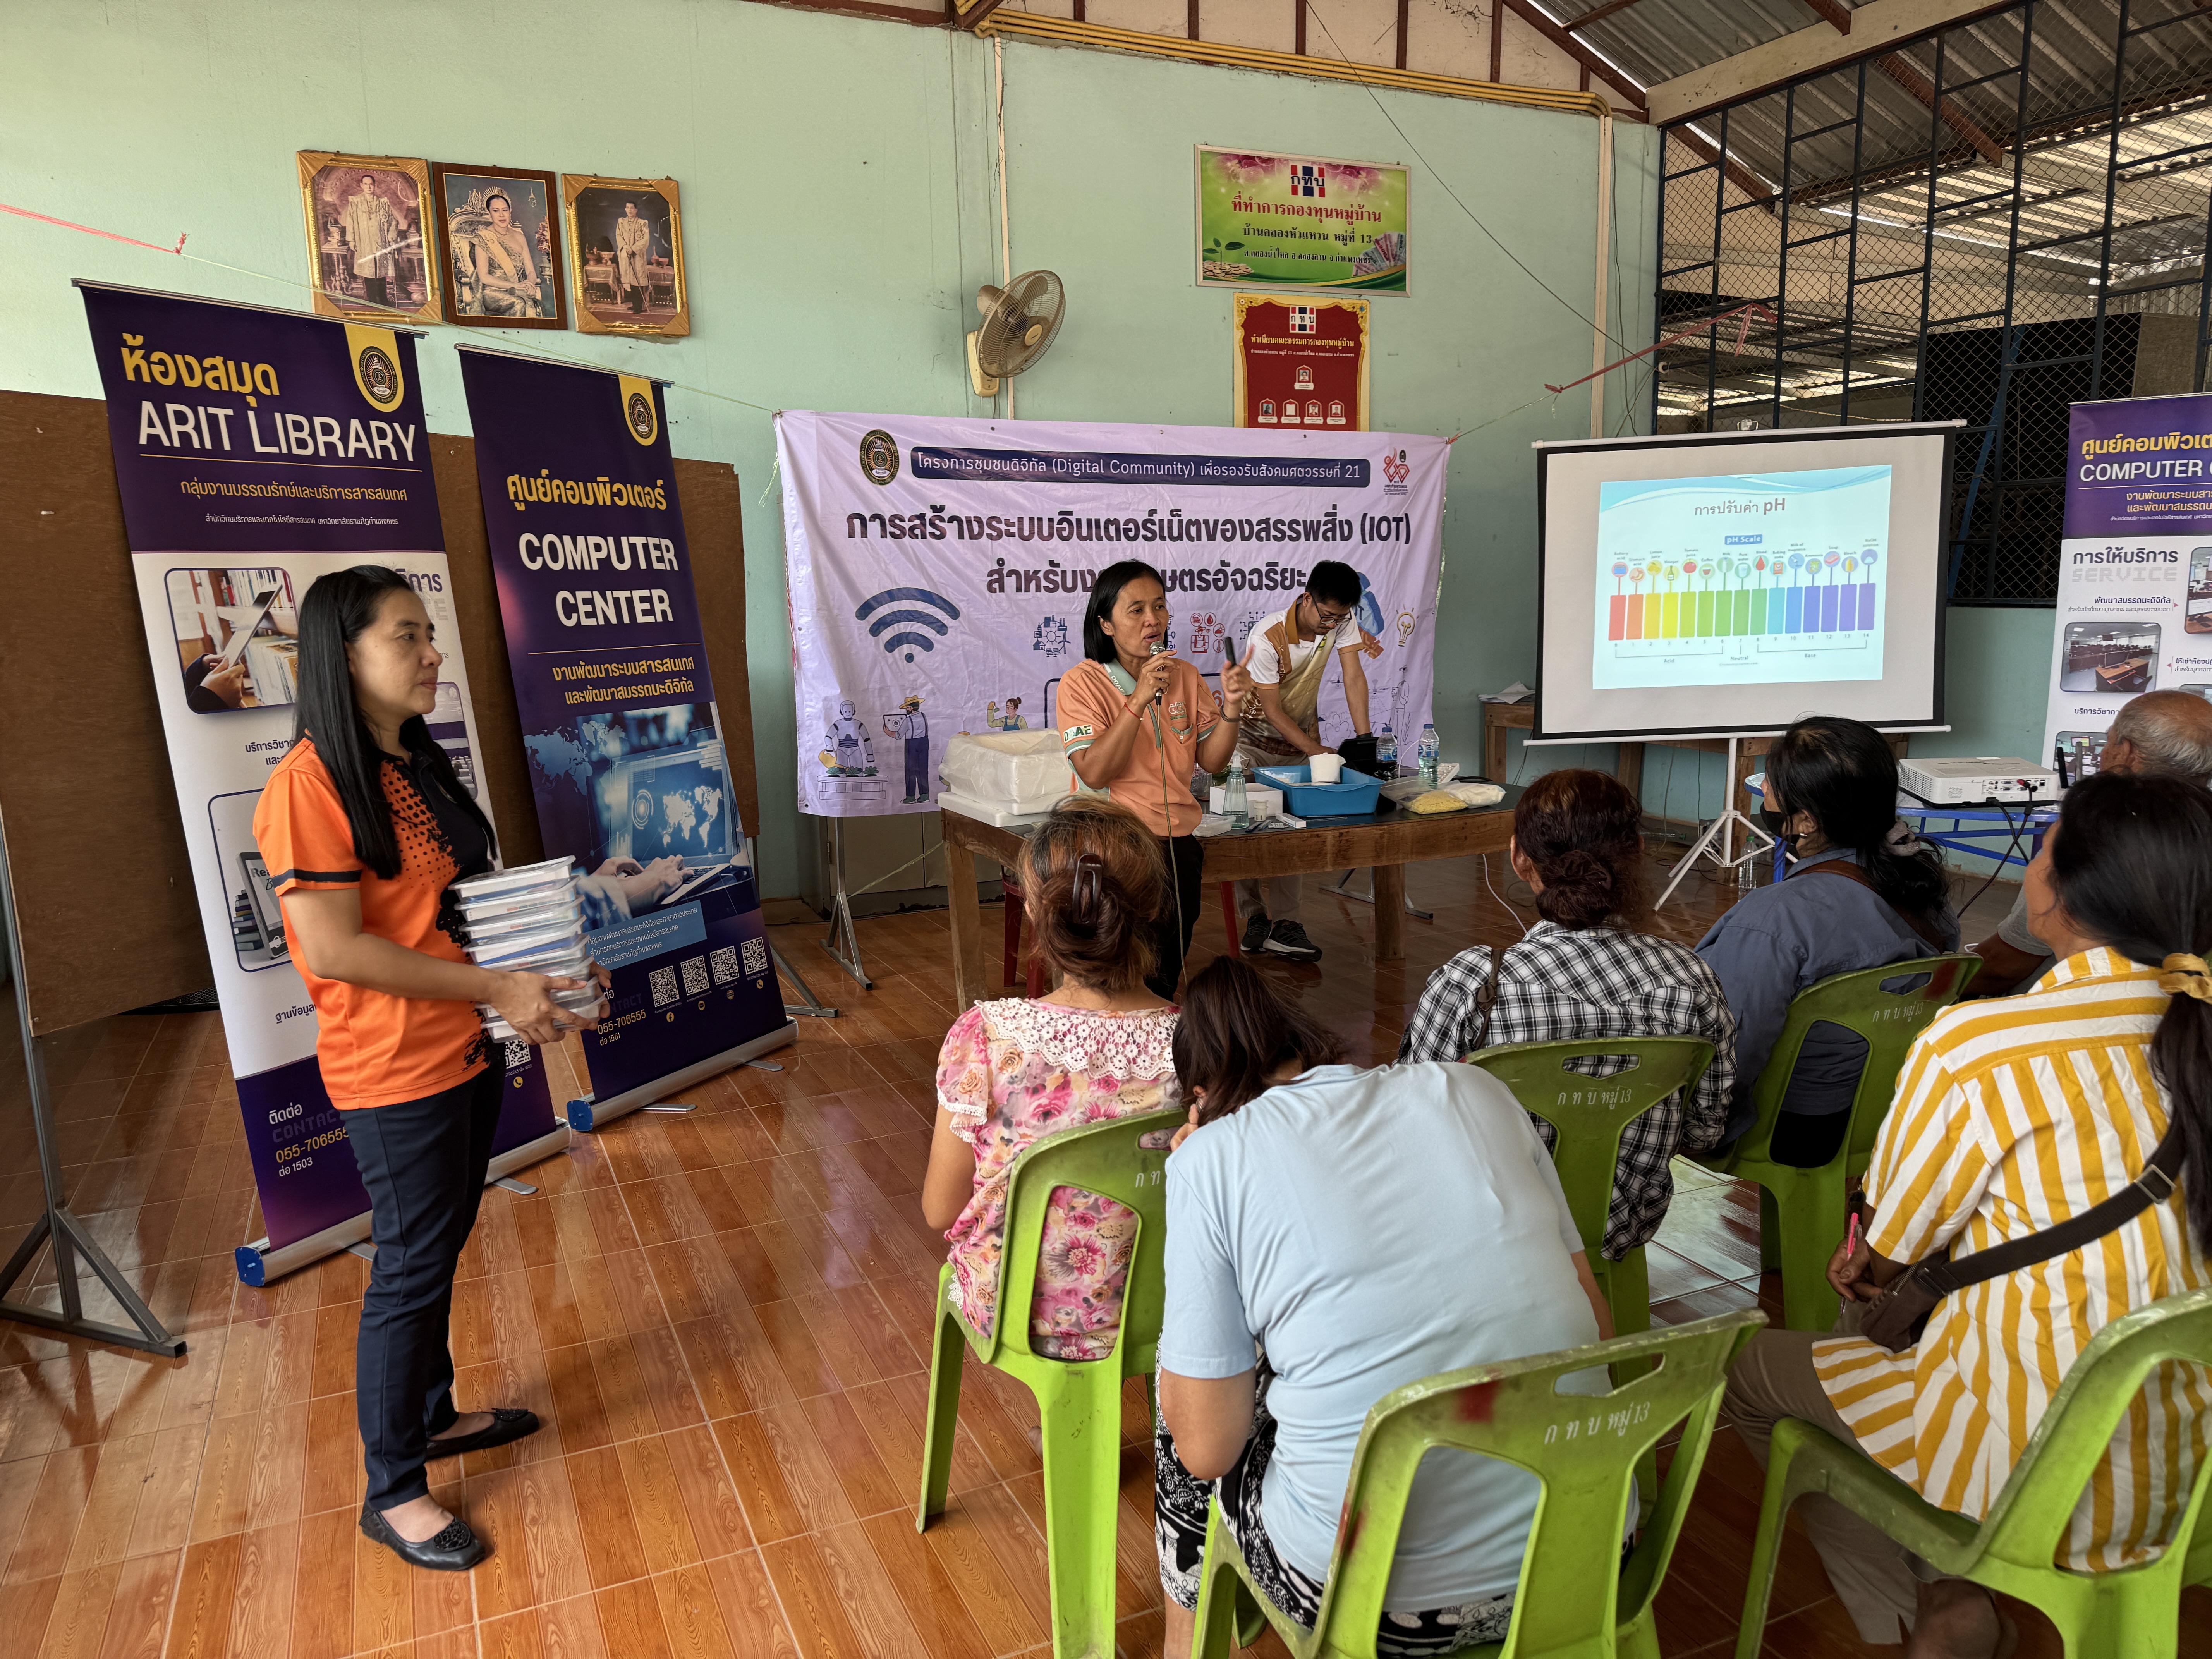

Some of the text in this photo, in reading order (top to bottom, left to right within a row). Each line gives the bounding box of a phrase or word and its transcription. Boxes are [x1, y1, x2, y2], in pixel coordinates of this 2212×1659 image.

[1290, 174, 1325, 187] กทบ
[1231, 191, 1381, 225] ที่ทำการกองทุนหมู่บ้าน
[1243, 223, 1372, 246] บ้านคลองหัวแหวน หมู่ที่ 13
[121, 333, 280, 407] ห้องสมุด
[139, 400, 415, 461] ARIT LIBRARY
[918, 452, 1360, 479] โครงการชุมชนดิจิทัล (Digital Community) เพื่อรองรับสังคมศตวรรษที่ 21
[2080, 460, 2203, 481] COMPUTER
[180, 477, 408, 501] กลุ่มงานบรรณรักษ์และบริการสารสนเทศ
[507, 469, 667, 511] ศูนย์คอมพิวเตอร์
[1695, 498, 1785, 515] การปรับค่า pH
[846, 504, 1411, 544] การสร้างระบบอินเตอร์เน็ตของสรรพสิ่ง (IOT)
[519, 533, 679, 571] COMPUTER
[2073, 546, 2178, 564] การให้บริการ
[2072, 567, 2178, 582] SERVICE
[556, 589, 674, 627] CENTER
[552, 656, 695, 681] งานพัฒนาระบบสารสนเทศ
[565, 676, 694, 704] และพัฒนาสมรรถนะดิจิทัล
[598, 1009, 646, 1034] 055-706555
[609, 1032, 620, 1042] 1561
[269, 1102, 303, 1125] ติดต่อ
[278, 1157, 313, 1177] ต่อ 1503
